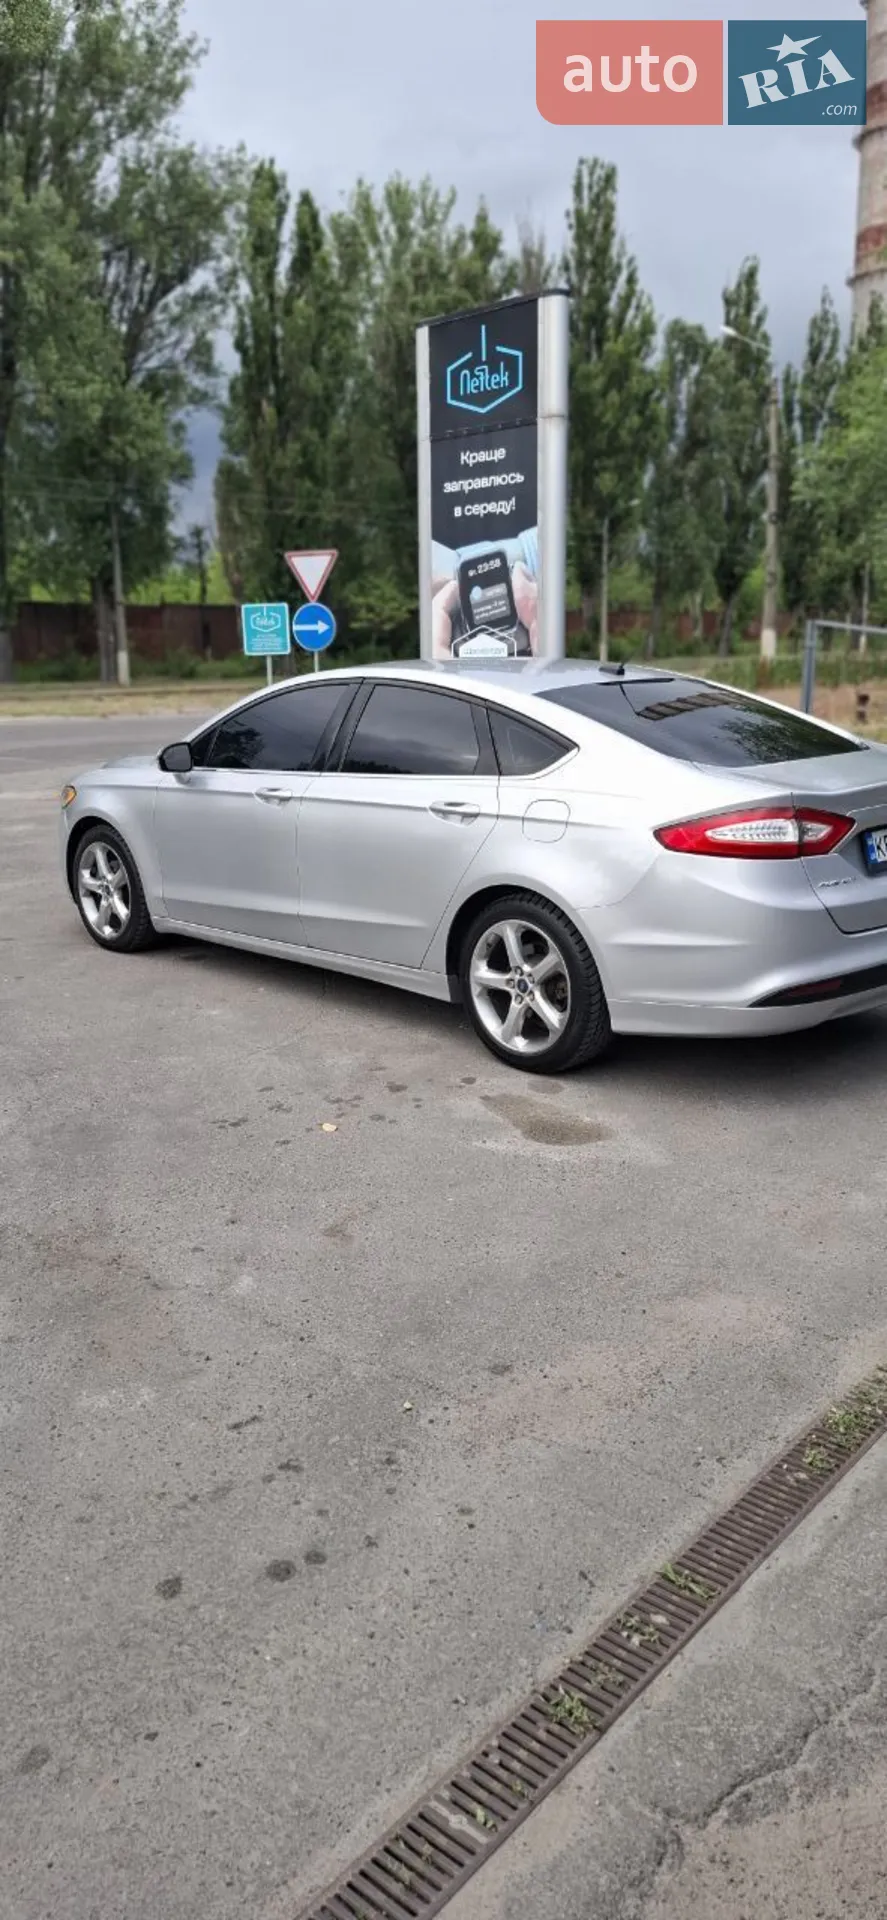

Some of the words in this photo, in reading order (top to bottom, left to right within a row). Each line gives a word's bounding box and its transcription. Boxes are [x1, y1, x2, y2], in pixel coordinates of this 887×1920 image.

[460, 447, 506, 467] Краще
[443, 472, 525, 494] заправлюсь
[454, 506, 462, 517] в
[464, 496, 516, 518] середу!
